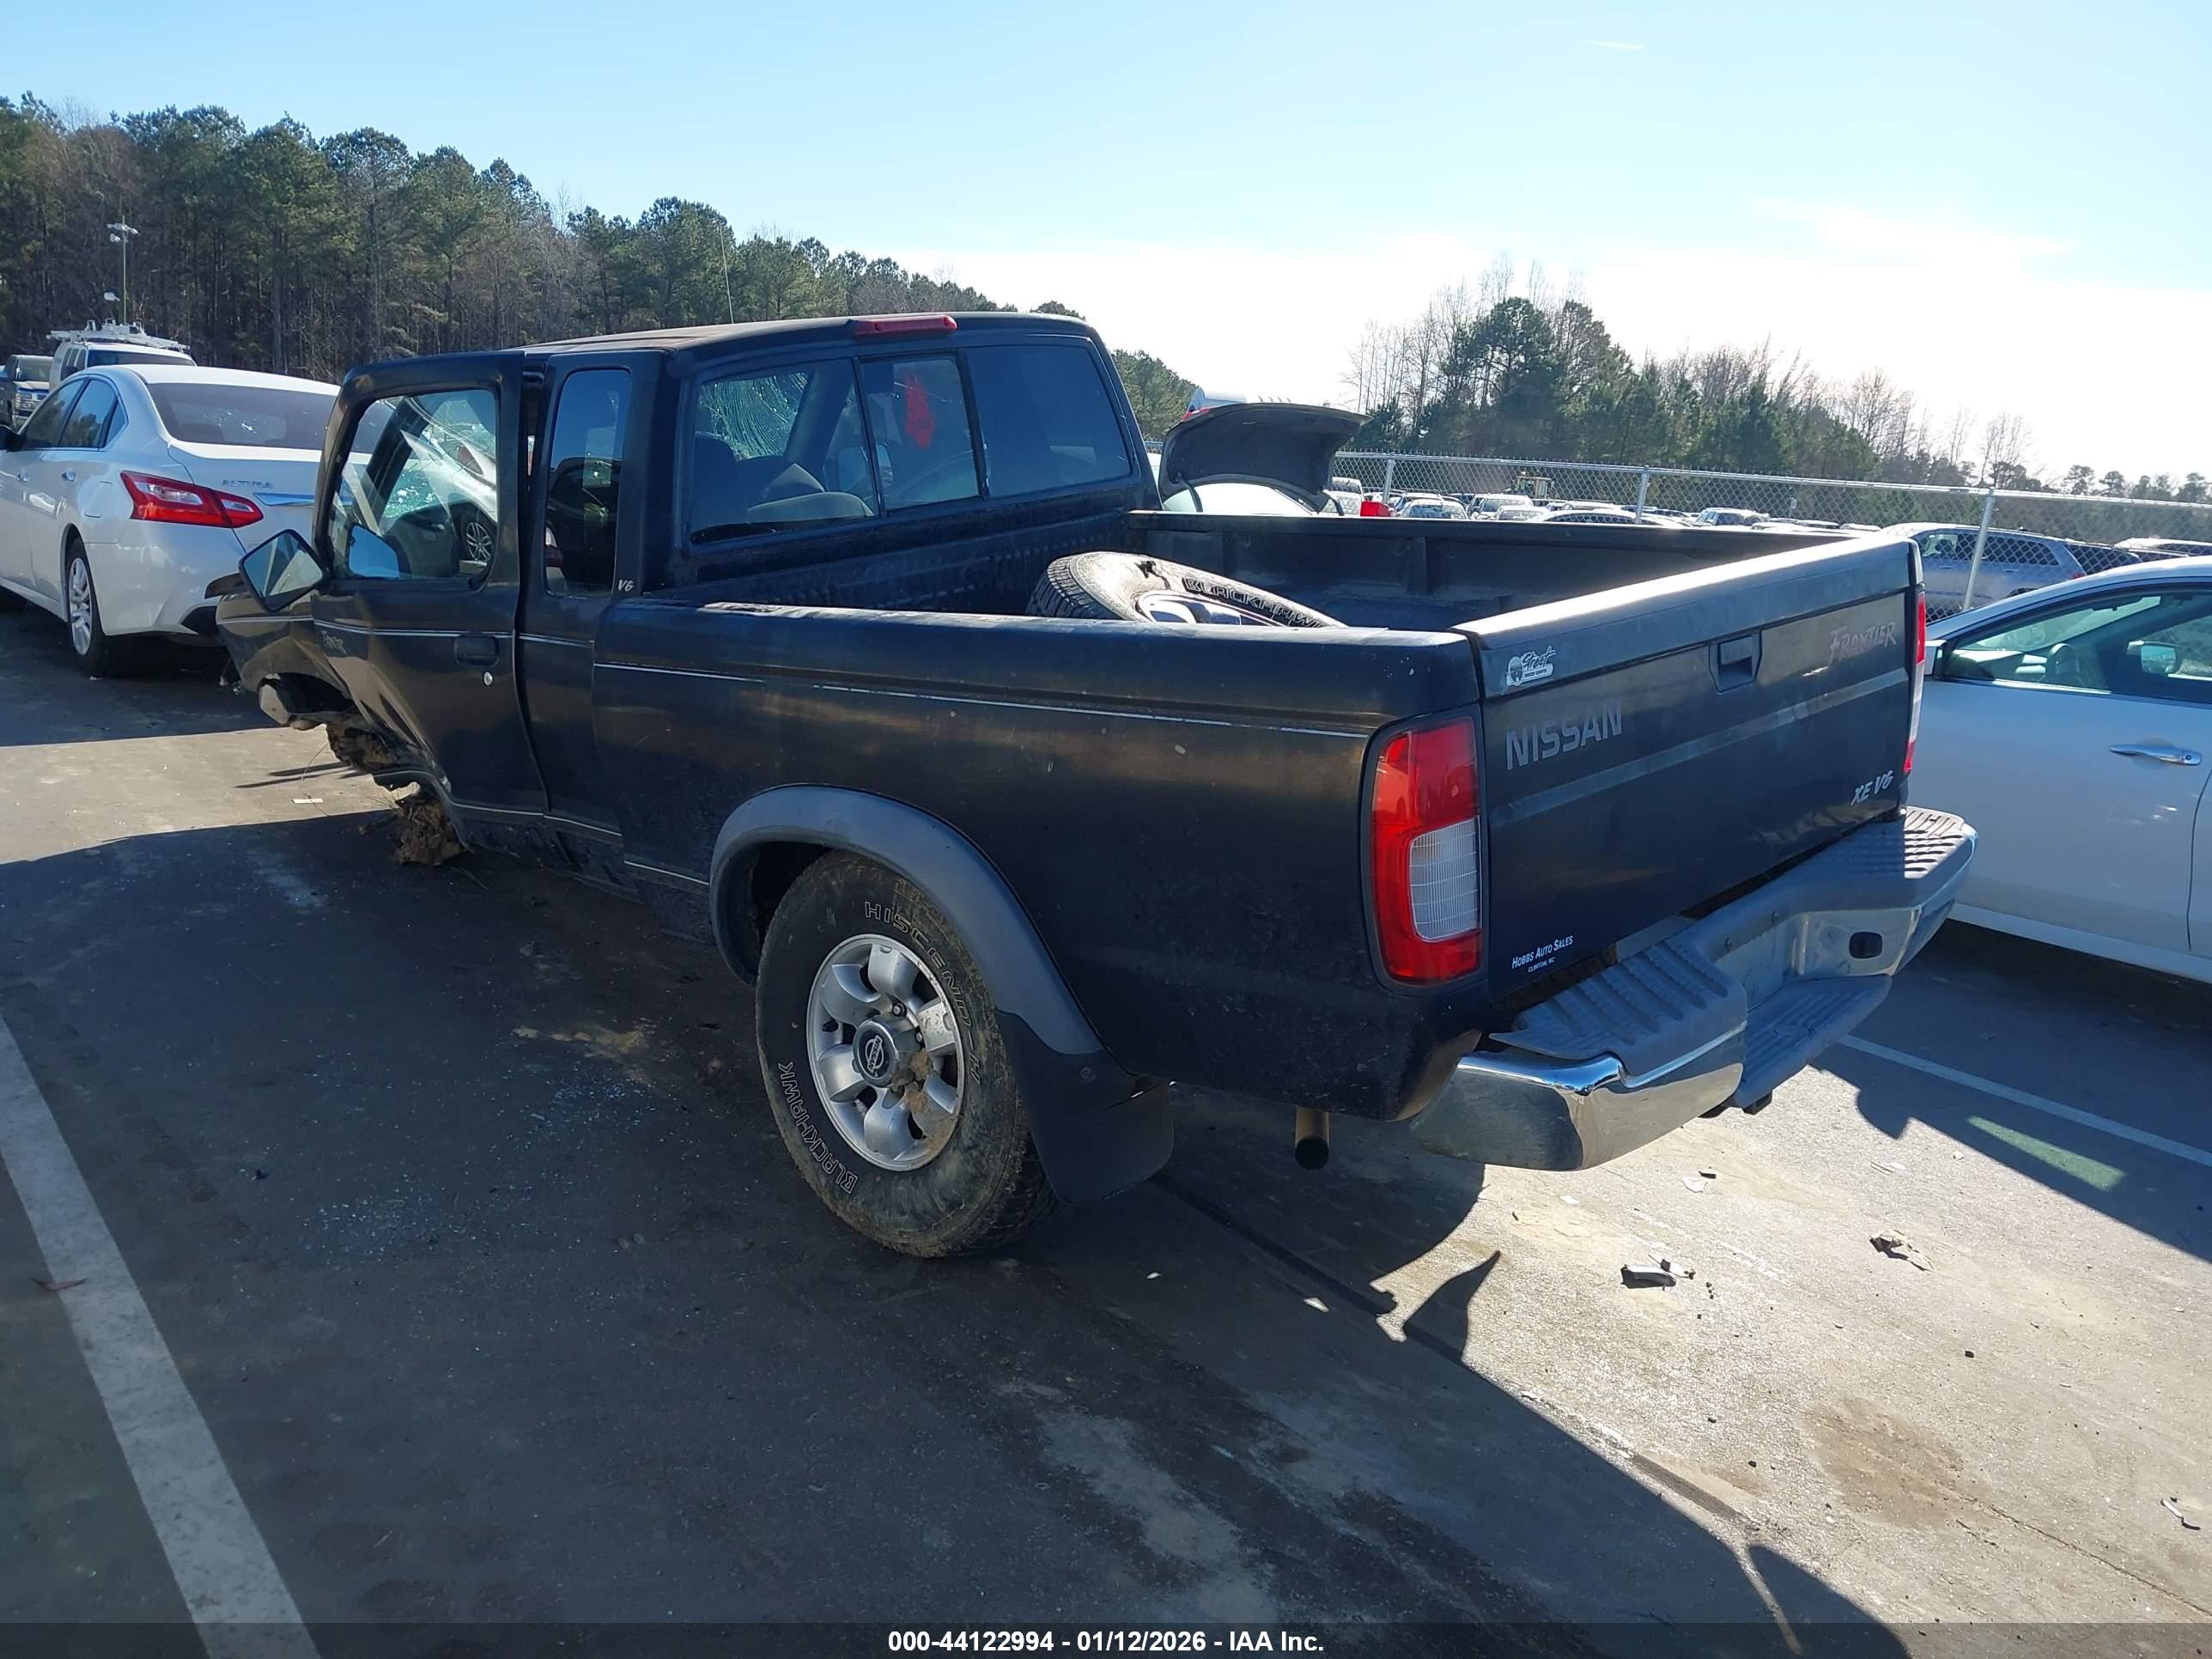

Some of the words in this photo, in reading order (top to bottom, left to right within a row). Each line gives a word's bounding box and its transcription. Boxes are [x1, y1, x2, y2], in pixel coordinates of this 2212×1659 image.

[617, 579, 634, 592] V6
[1506, 701, 1622, 770] NISSAN
[1850, 781, 1873, 806] XE
[1874, 769, 1894, 794] V6
[1511, 951, 1534, 969] HOBBS
[1535, 944, 1553, 958] AUTO
[1553, 935, 1573, 951] SALES
[778, 1061, 858, 1194] BLACKHAWK
